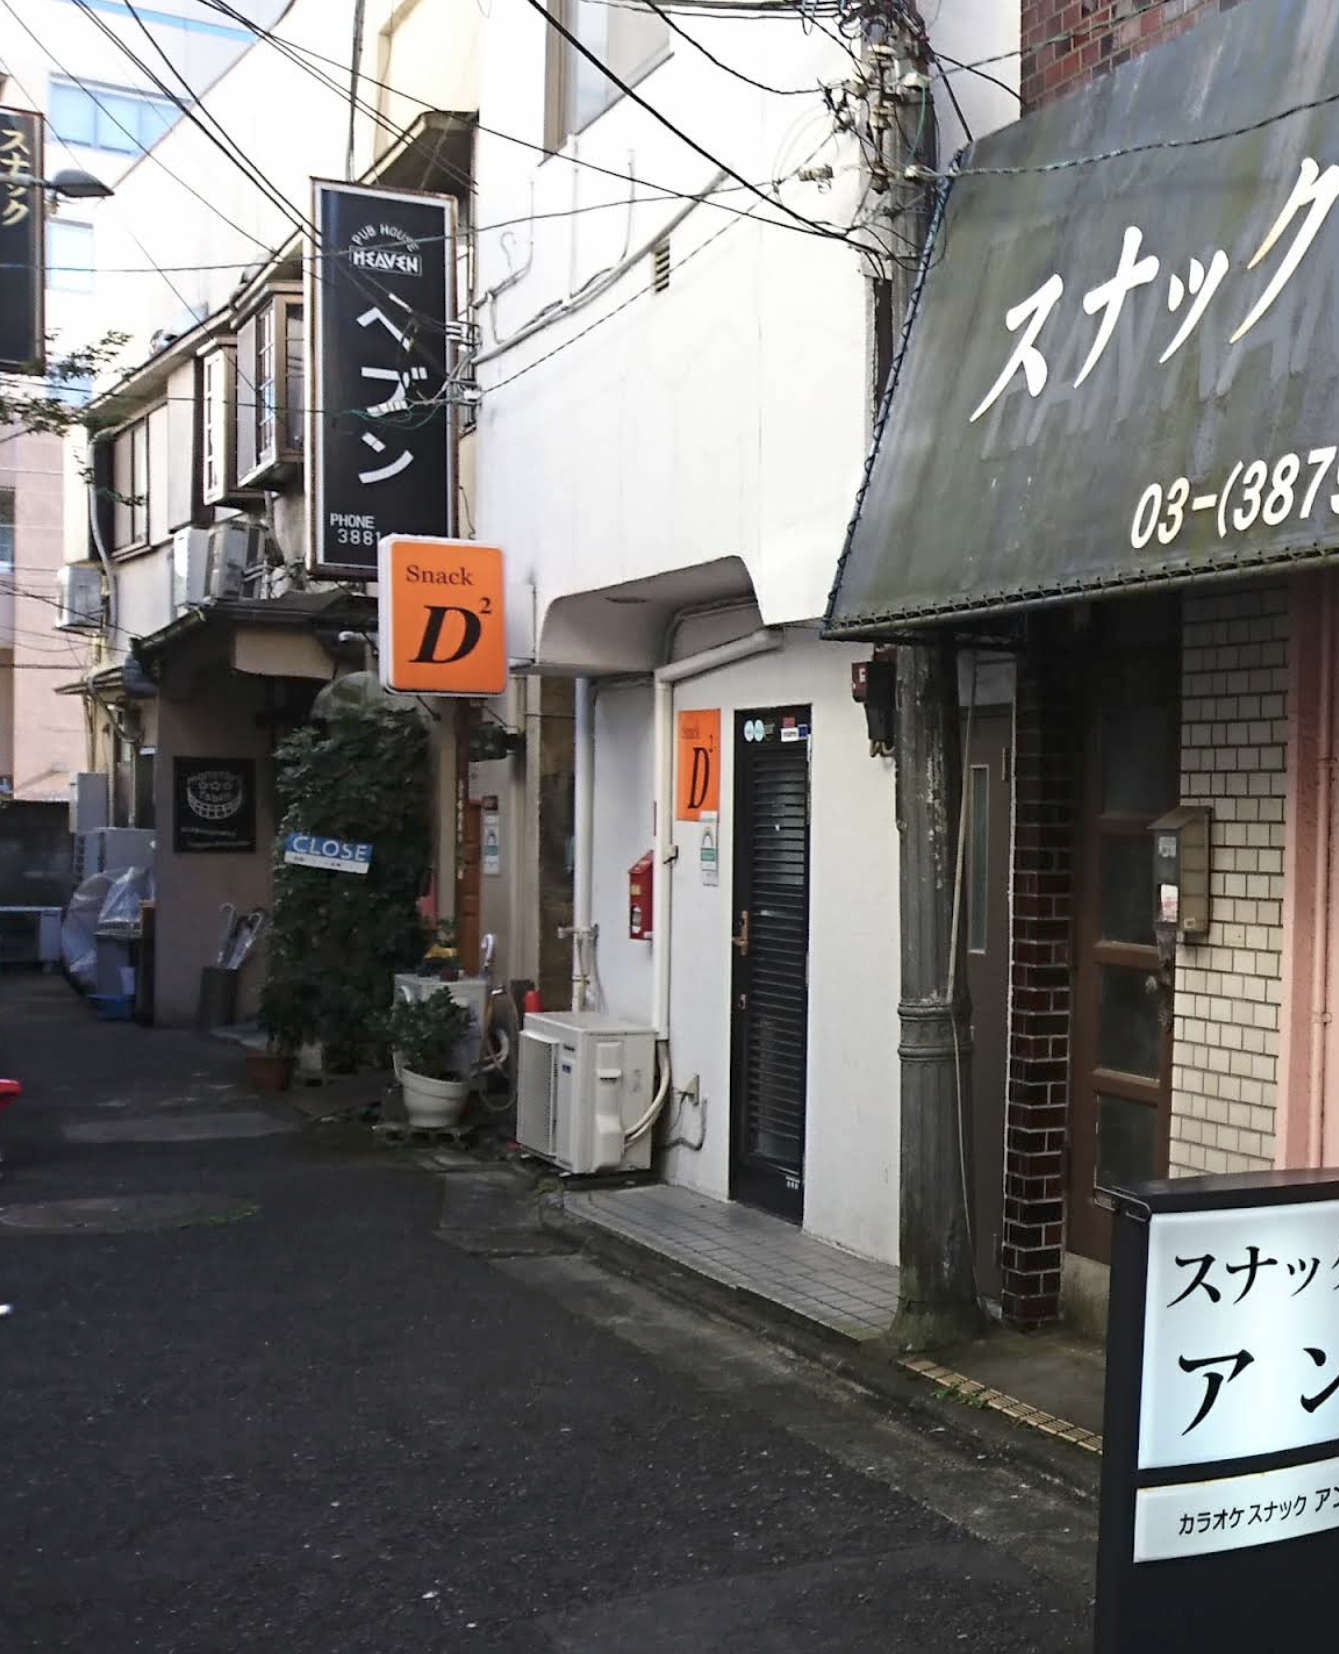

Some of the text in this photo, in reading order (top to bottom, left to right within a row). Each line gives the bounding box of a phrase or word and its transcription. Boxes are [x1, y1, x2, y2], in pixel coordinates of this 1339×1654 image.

[351, 223, 420, 252] PUB HOUSE
[353, 250, 418, 273] HEAVEN
[356, 306, 429, 484] ヘブン
[329, 513, 376, 529] PHONE
[405, 564, 475, 586] Snack
[292, 835, 368, 862] CLOSE
